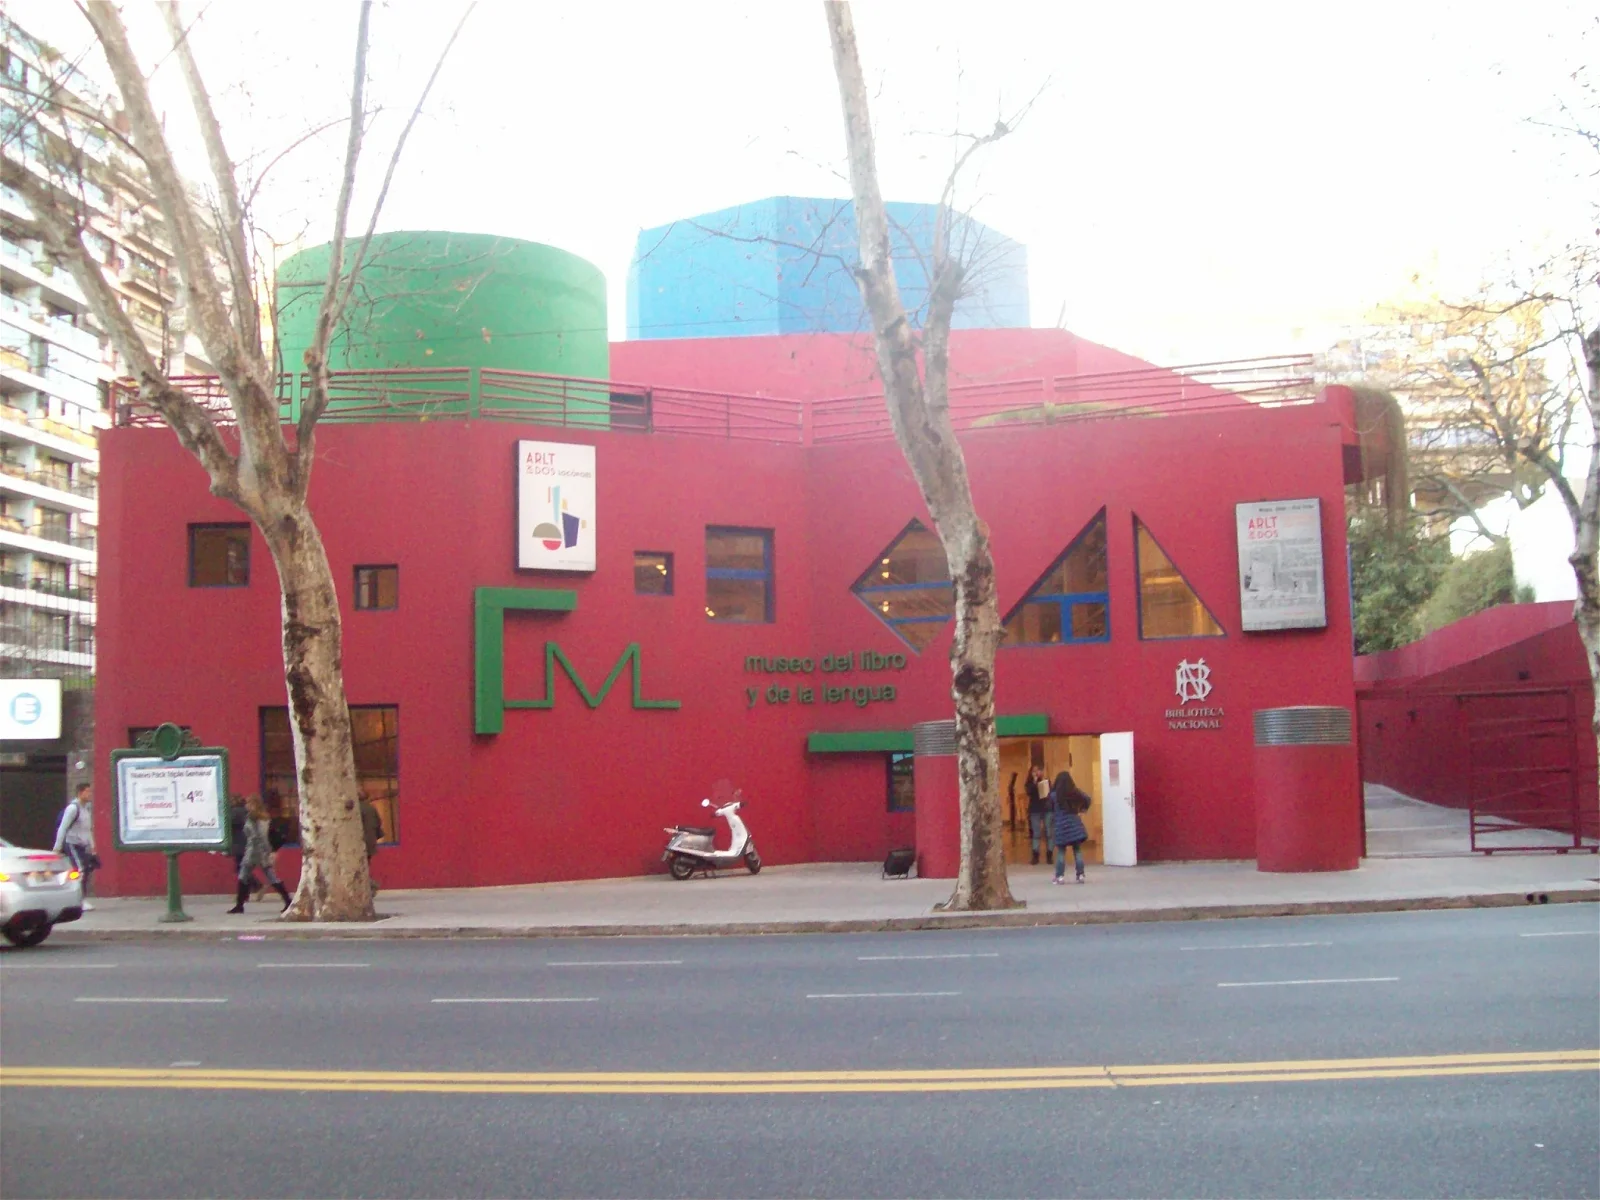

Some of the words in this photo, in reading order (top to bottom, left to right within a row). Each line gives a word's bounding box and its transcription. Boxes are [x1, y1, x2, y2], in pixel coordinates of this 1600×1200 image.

[526, 451, 556, 465] ARLT
[1248, 516, 1278, 529] ARLT
[745, 655, 815, 673] museo
[821, 652, 854, 672] del
[860, 649, 907, 671] libro
[746, 686, 759, 708] y
[766, 683, 791, 704] de
[798, 683, 814, 704] la
[821, 681, 896, 707] lengua
[1165, 707, 1224, 718] BIBLIOTECA
[1169, 719, 1222, 730] NACIONAL
